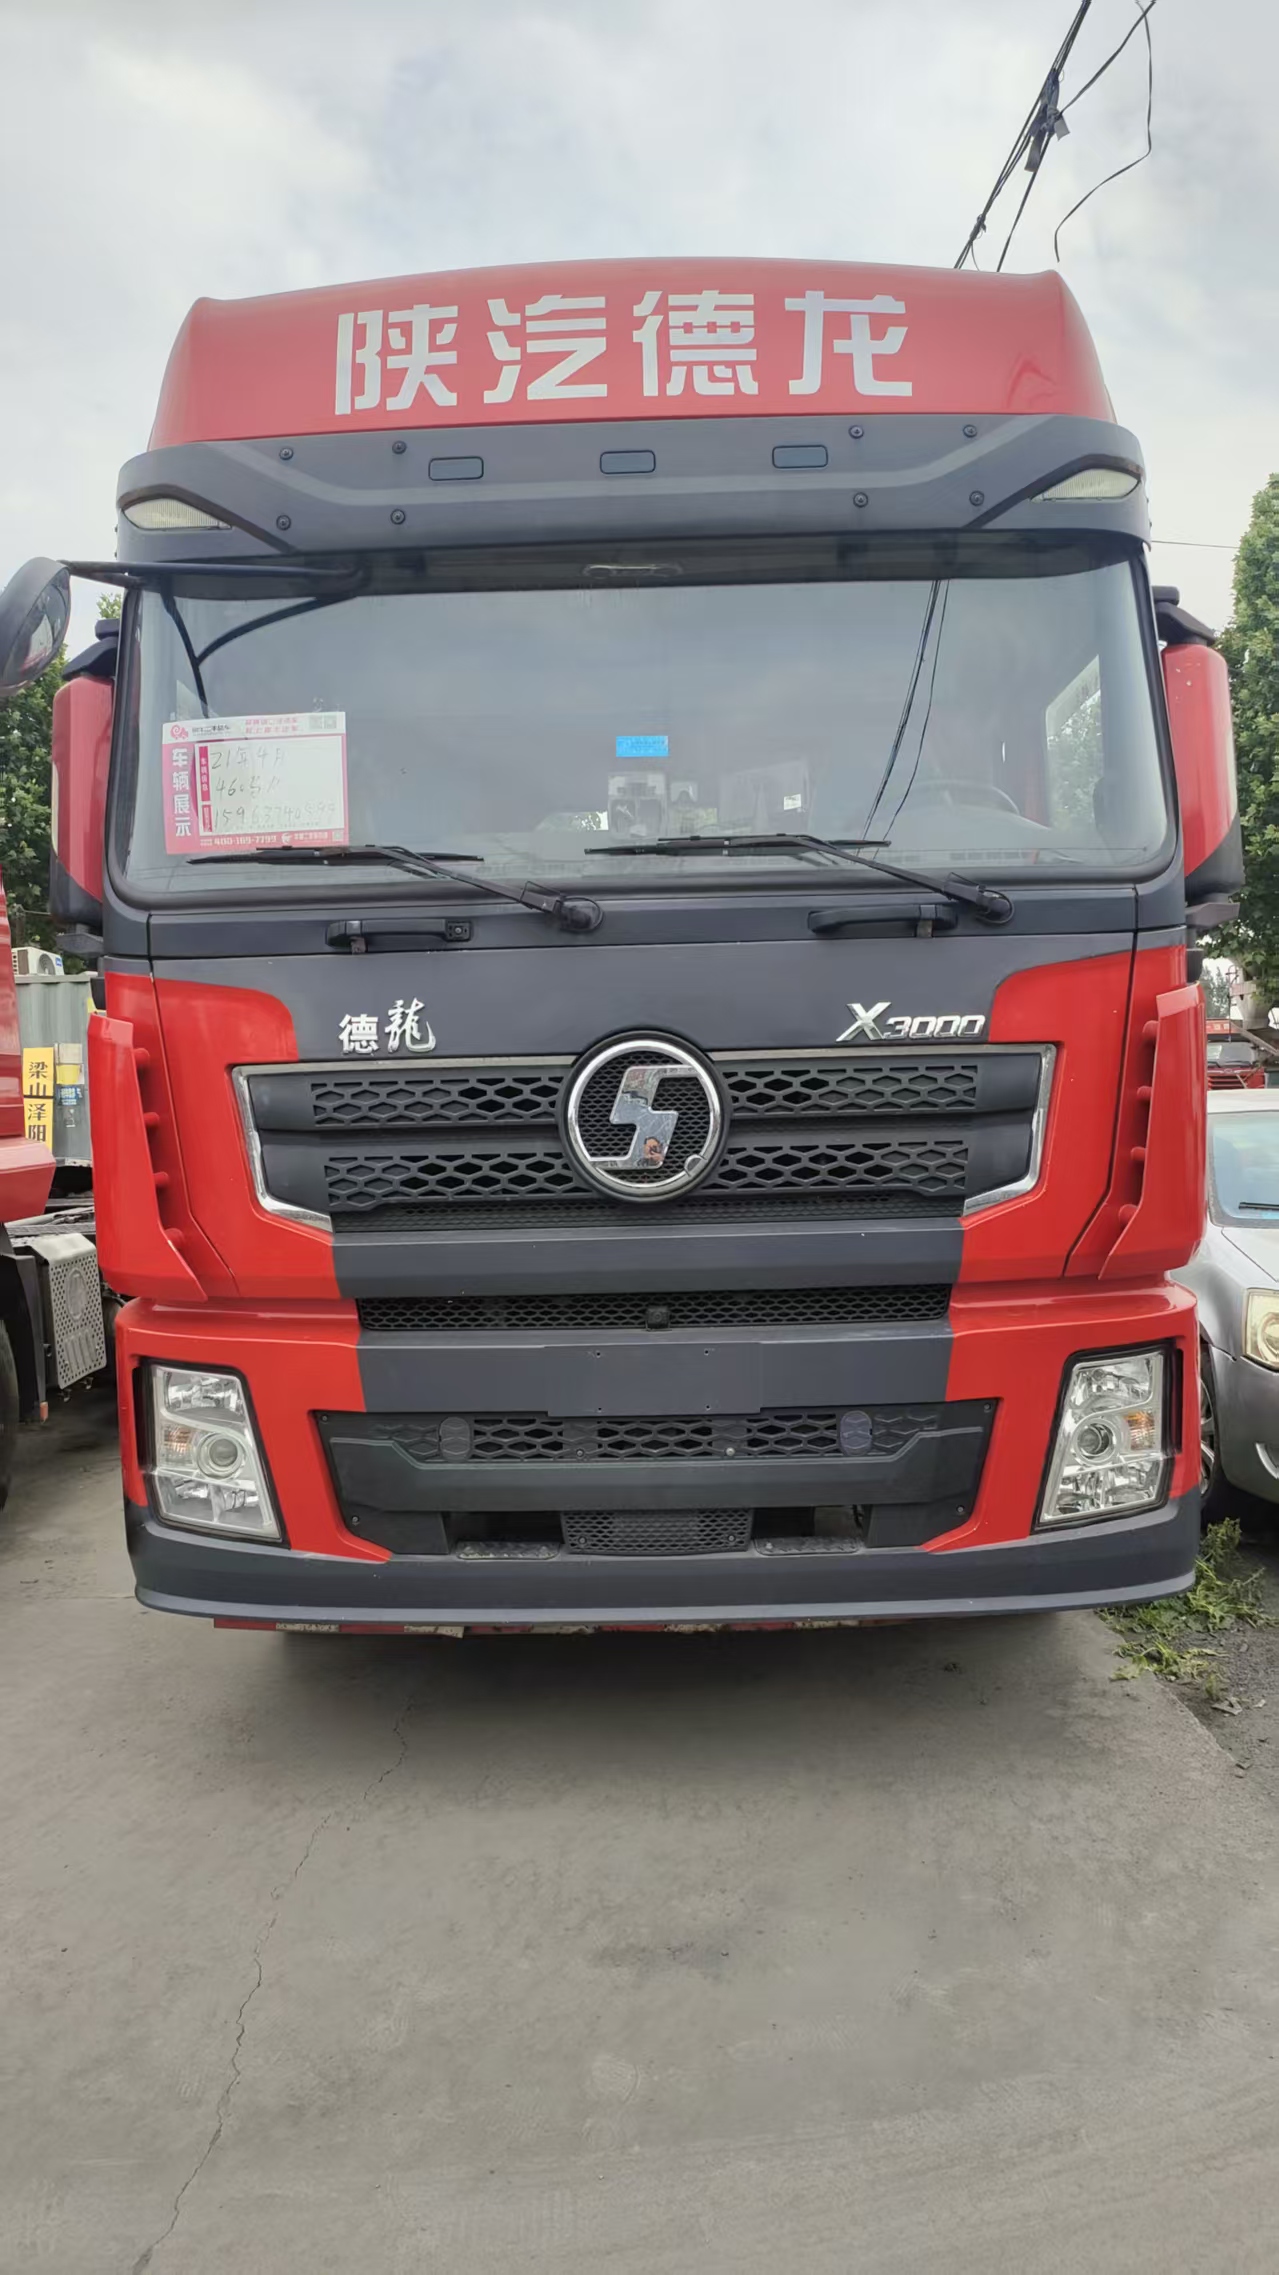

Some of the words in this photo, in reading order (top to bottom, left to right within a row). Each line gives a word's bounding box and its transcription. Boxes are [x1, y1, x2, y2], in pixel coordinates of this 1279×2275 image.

[335, 290, 912, 415] 陕汽德龙
[172, 748, 191, 836] 车辆展示
[835, 1001, 985, 1042] X3000
